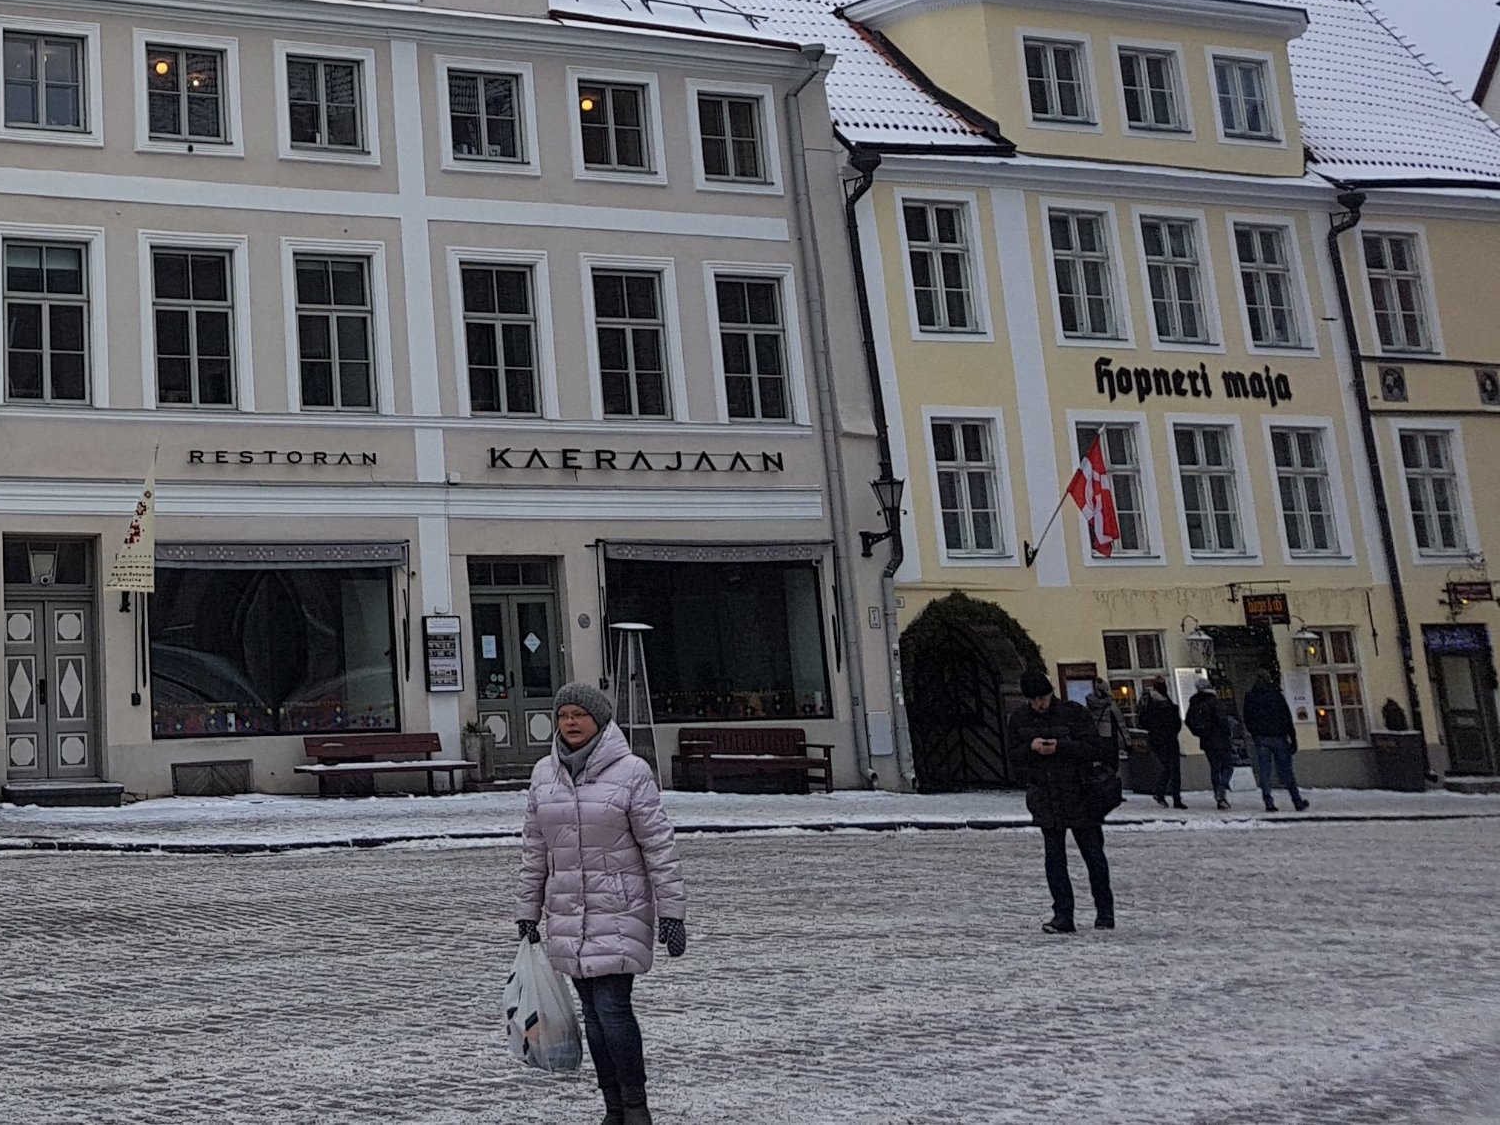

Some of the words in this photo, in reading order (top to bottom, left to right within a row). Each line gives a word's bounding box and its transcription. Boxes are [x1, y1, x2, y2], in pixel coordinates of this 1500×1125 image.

[1221, 363, 1293, 408] maja
[189, 449, 377, 466] RESTORAN
[489, 446, 785, 473] KAERAJAAN
